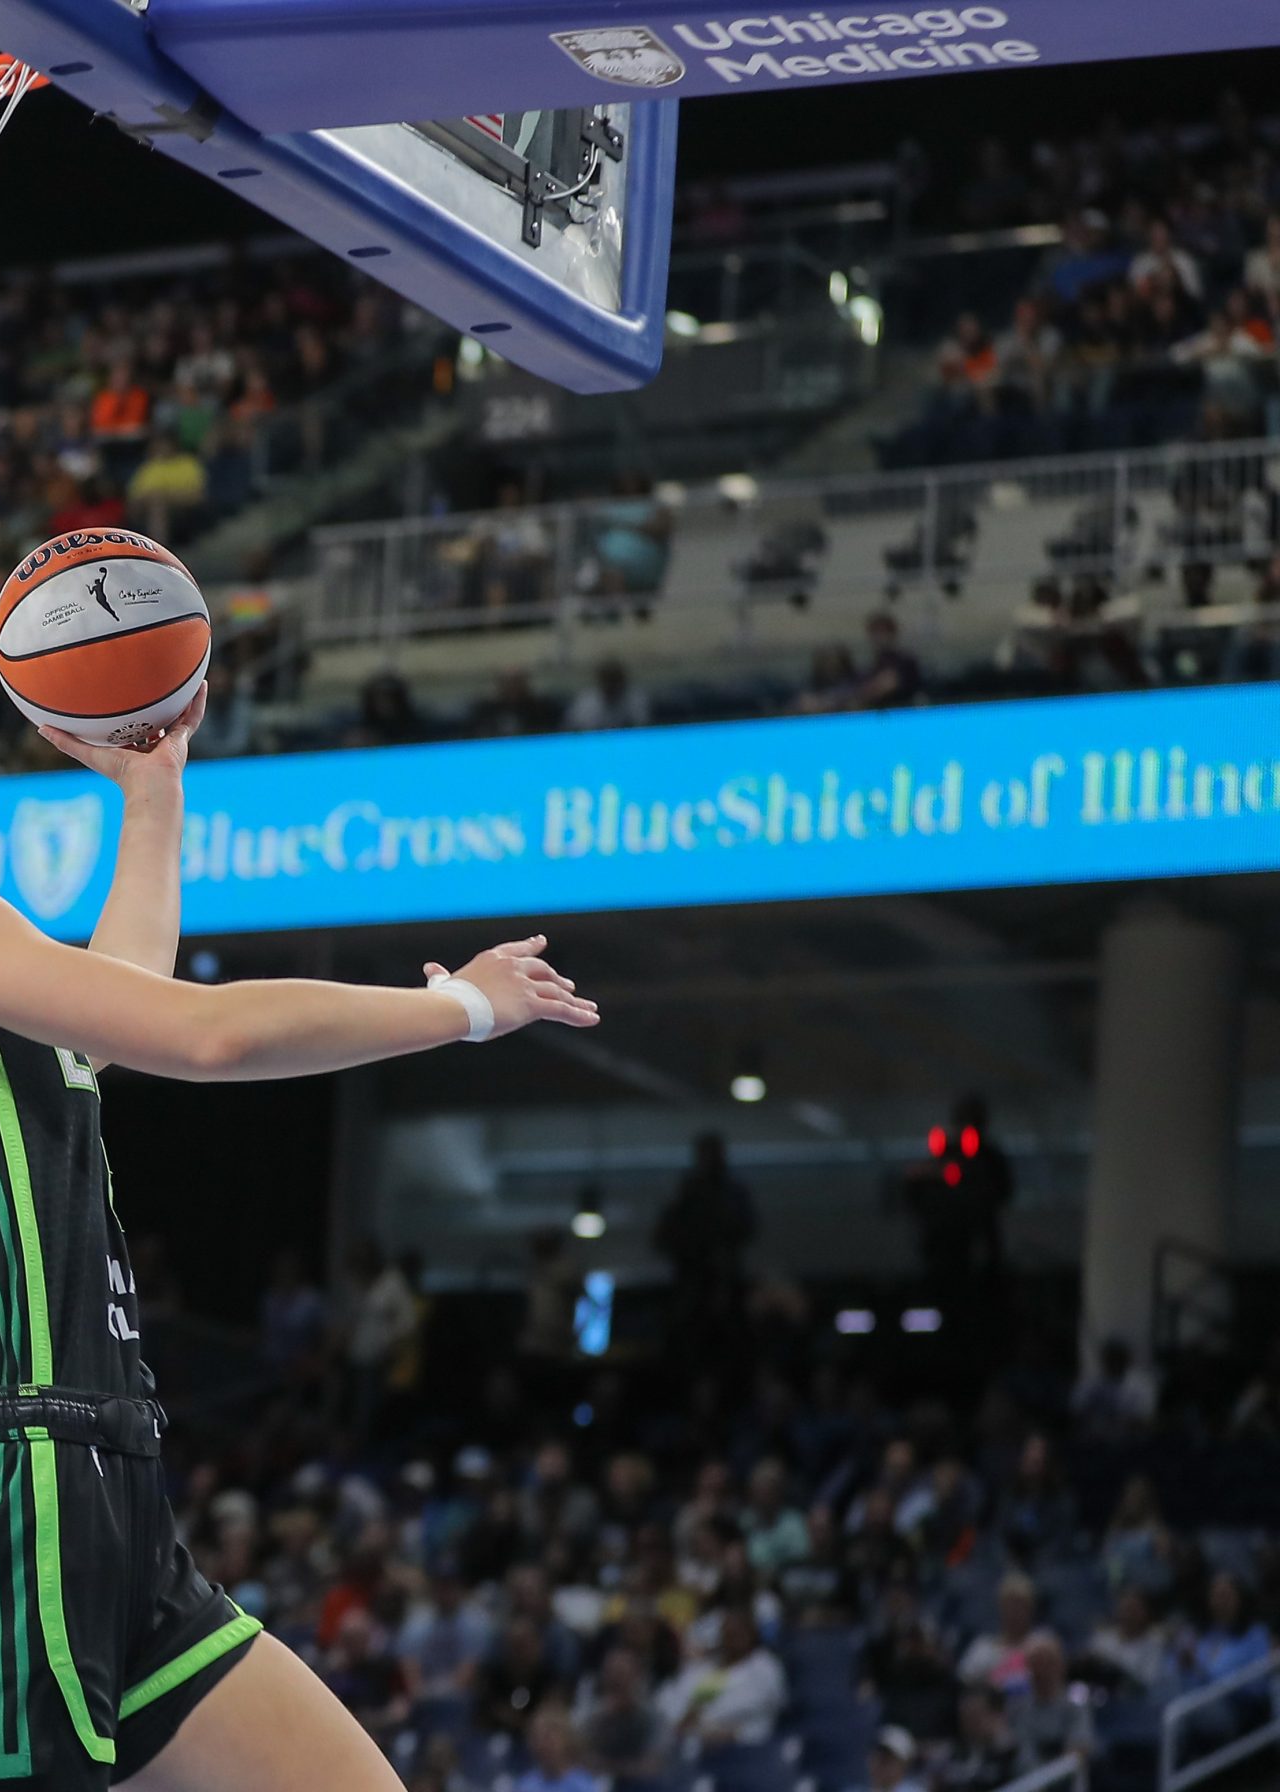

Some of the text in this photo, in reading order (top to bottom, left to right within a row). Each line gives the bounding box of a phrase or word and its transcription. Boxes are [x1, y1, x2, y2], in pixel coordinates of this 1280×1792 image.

[672, 7, 1008, 50] UChicago
[704, 39, 1041, 83] Medicine
[42, 613, 65, 627] GAME
[64, 606, 86, 617] BALL
[44, 602, 79, 619] OFFICIAL
[543, 759, 965, 860] BlueShield
[981, 753, 1066, 829] of
